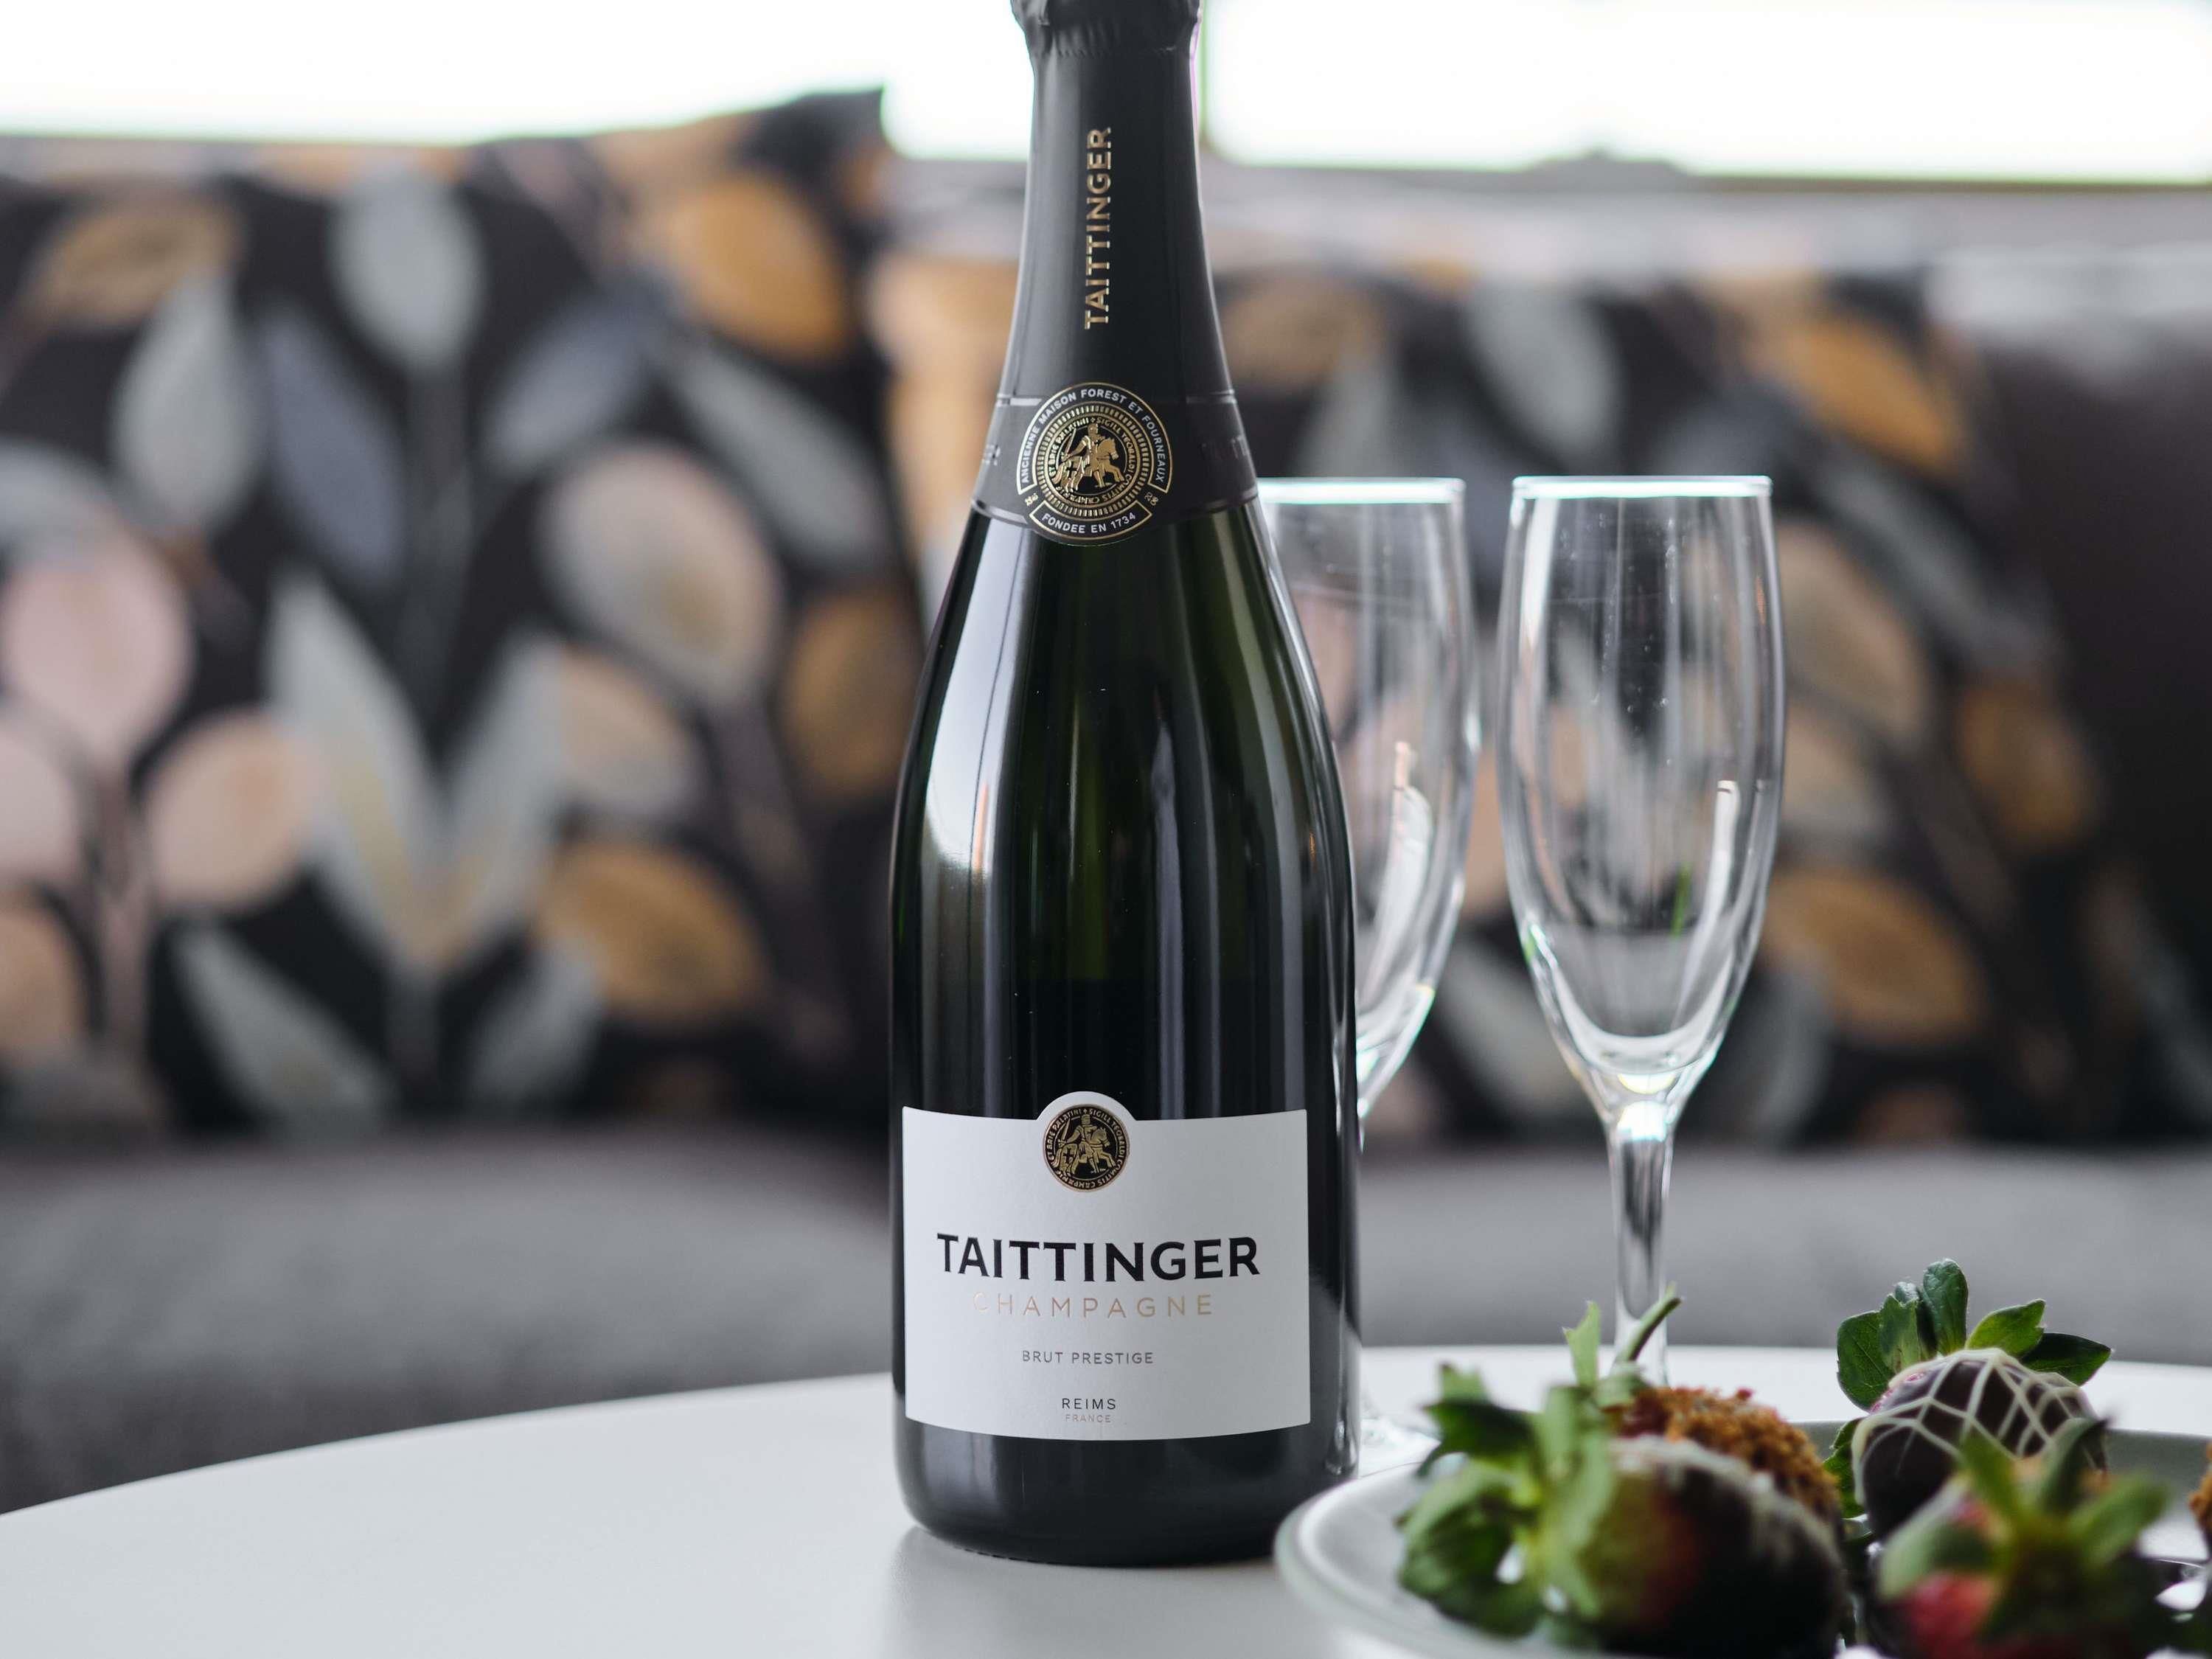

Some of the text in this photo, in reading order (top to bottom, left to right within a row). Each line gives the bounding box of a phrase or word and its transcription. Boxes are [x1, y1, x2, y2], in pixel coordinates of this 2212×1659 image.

[1085, 127, 1112, 330] TAITTINGER
[1021, 426, 1040, 484] ANCIENNE
[1038, 392, 1077, 425] MAISON
[1081, 389, 1127, 403] FOREST
[1128, 402, 1142, 414] ET
[1141, 416, 1166, 482] FOURNEAUX
[1042, 512, 1136, 533] FONDEE EN 1734
[936, 1233, 1260, 1281] TAITTINGER
[973, 1291, 1212, 1318] CHAMPAGNE
[1022, 1350, 1154, 1365] BRUT PRESTIGE
[1062, 1398, 1116, 1410] REIMS
[1065, 1413, 1111, 1423] FRANCE
